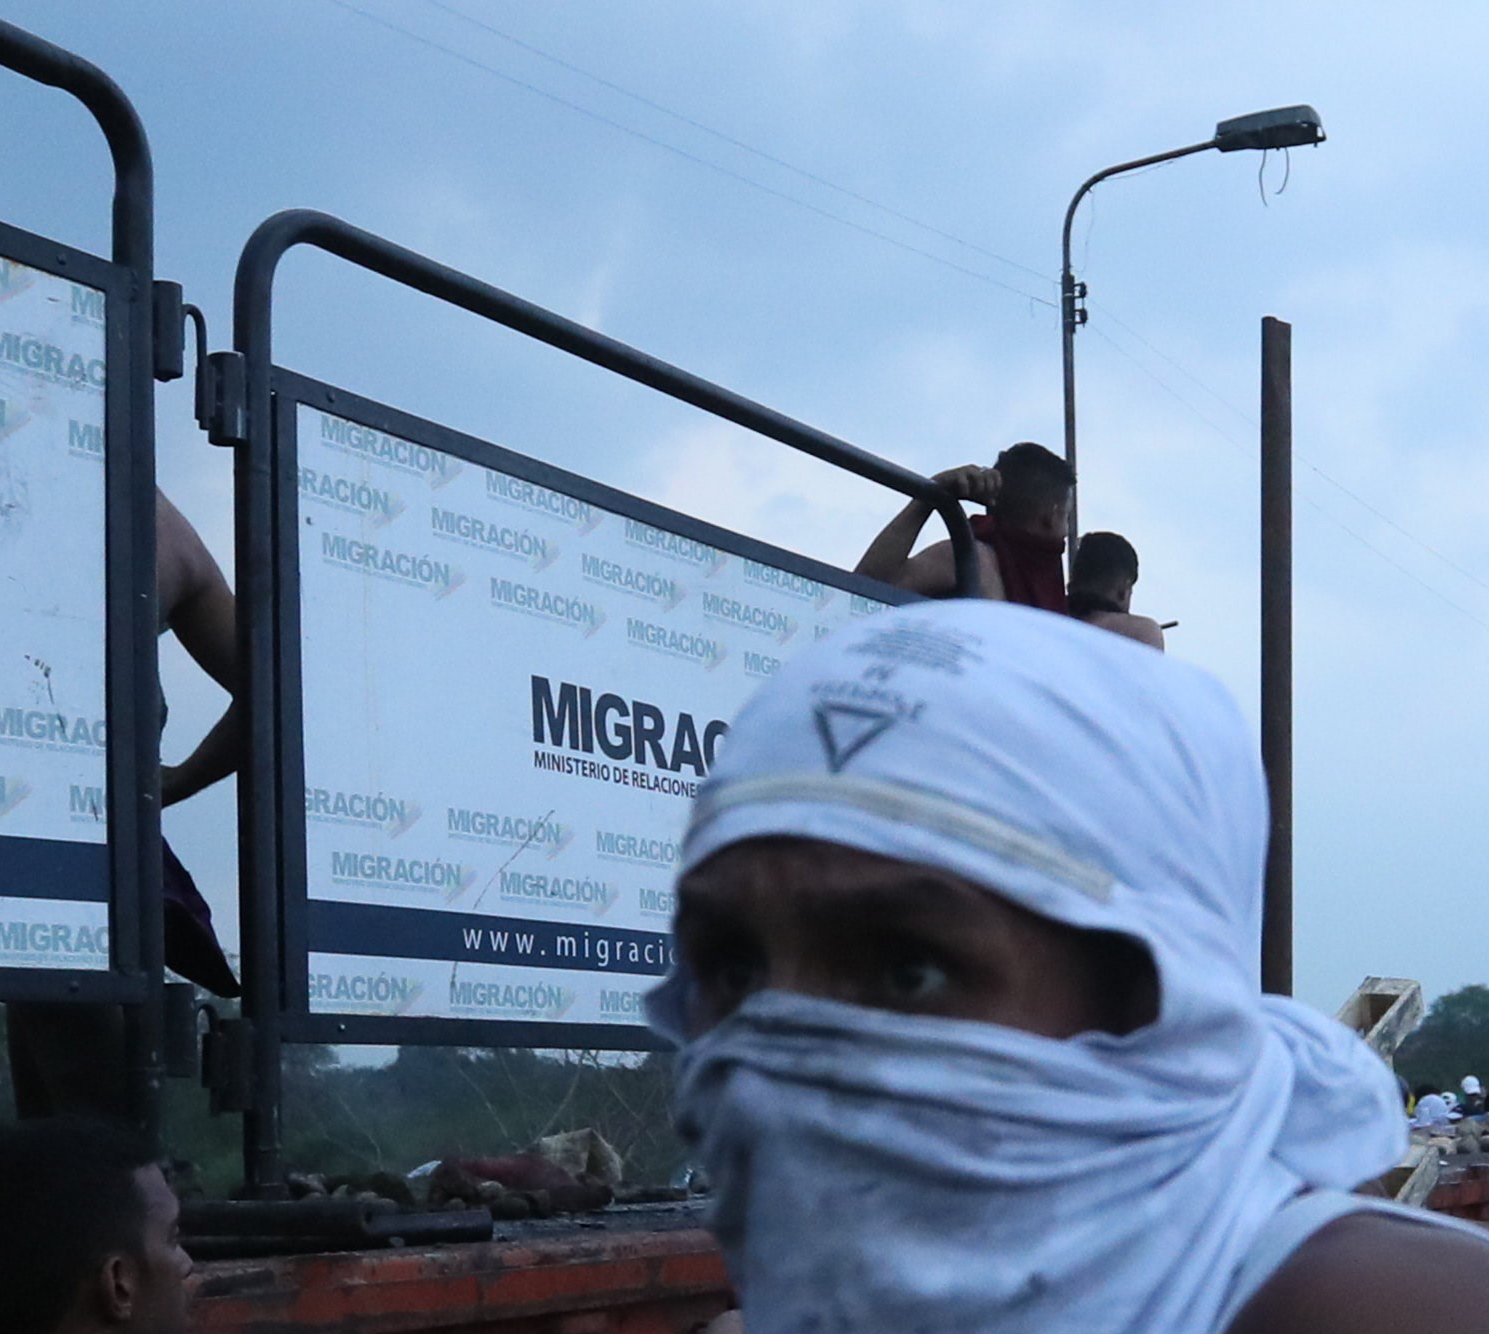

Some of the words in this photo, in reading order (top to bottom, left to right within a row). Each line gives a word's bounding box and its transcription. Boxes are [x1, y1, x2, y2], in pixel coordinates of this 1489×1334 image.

[433, 506, 544, 559] MIGRACIÓN
[323, 531, 448, 586] MIGRACIÓN
[581, 553, 676, 599] MIGRACIÓN
[490, 577, 596, 625] MIGRACIÓN
[704, 592, 786, 633] MIGRACIÓN
[627, 618, 717, 660] MIGRACIÓN
[534, 751, 610, 781] MINISTERIO
[613, 767, 630, 785] DE
[448, 809, 560, 844] MIGRACIÓN
[333, 852, 459, 887] MIGRACIÓN
[500, 872, 606, 903] MIGRACIÓN
